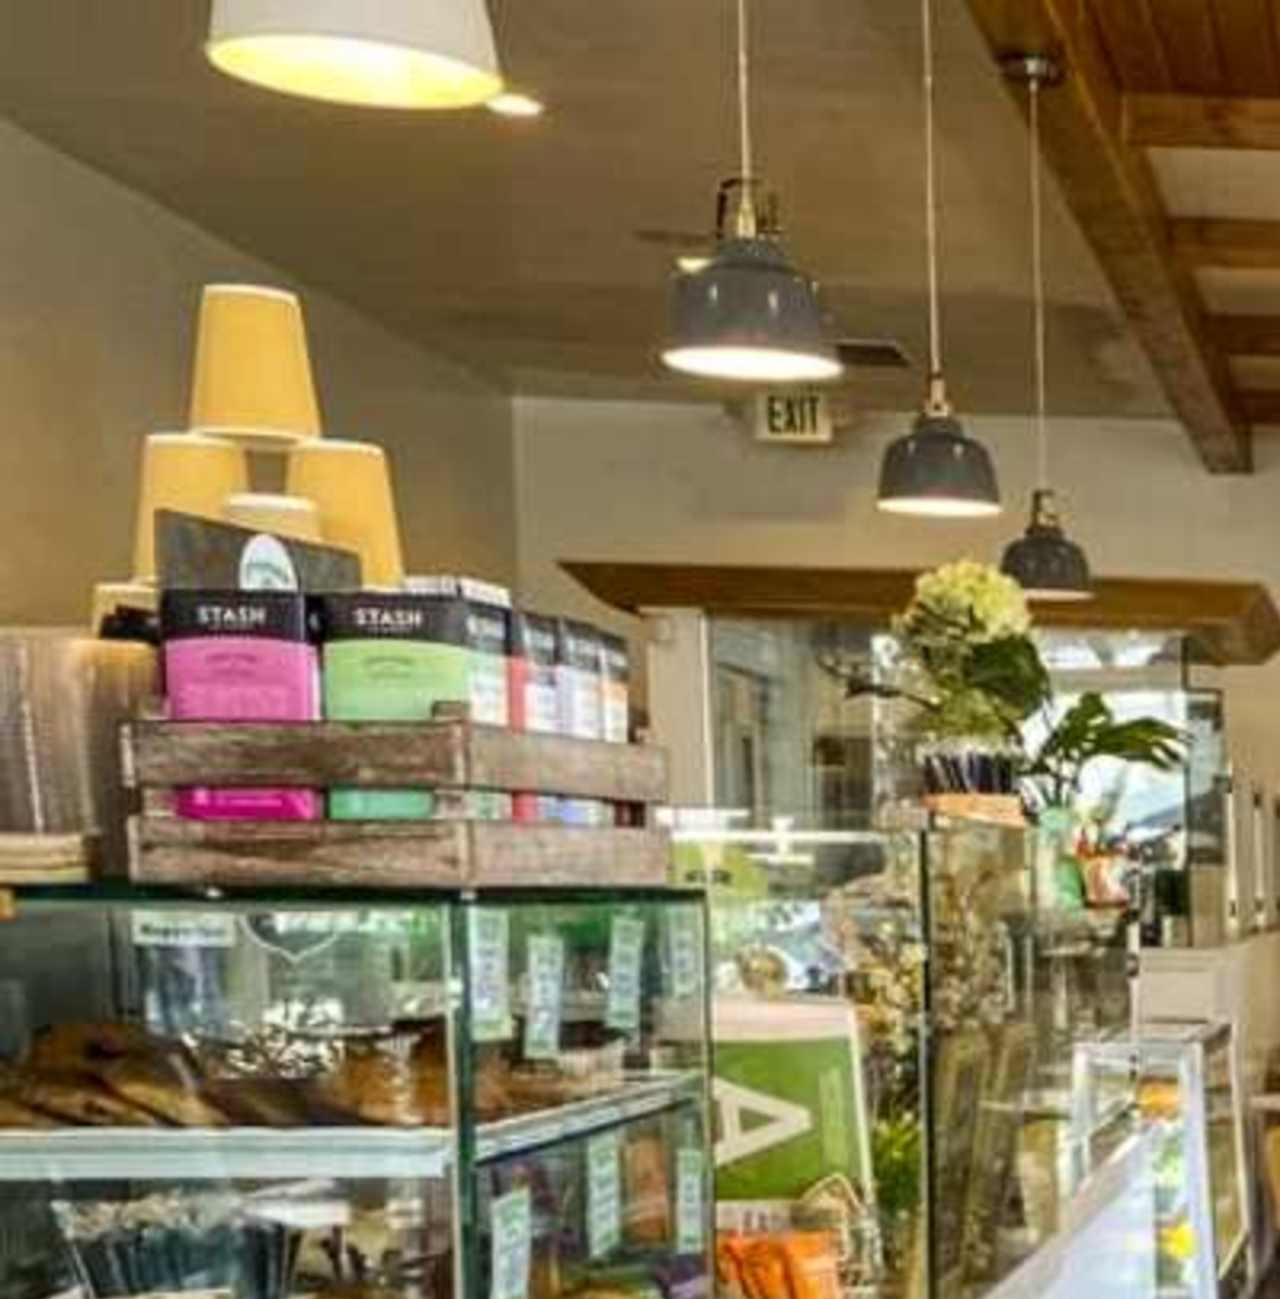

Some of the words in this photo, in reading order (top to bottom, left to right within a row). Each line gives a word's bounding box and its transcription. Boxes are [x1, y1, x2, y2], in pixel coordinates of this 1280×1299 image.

[768, 395, 819, 434] EXIT
[197, 605, 267, 625] STASH
[353, 607, 423, 627] STASH
